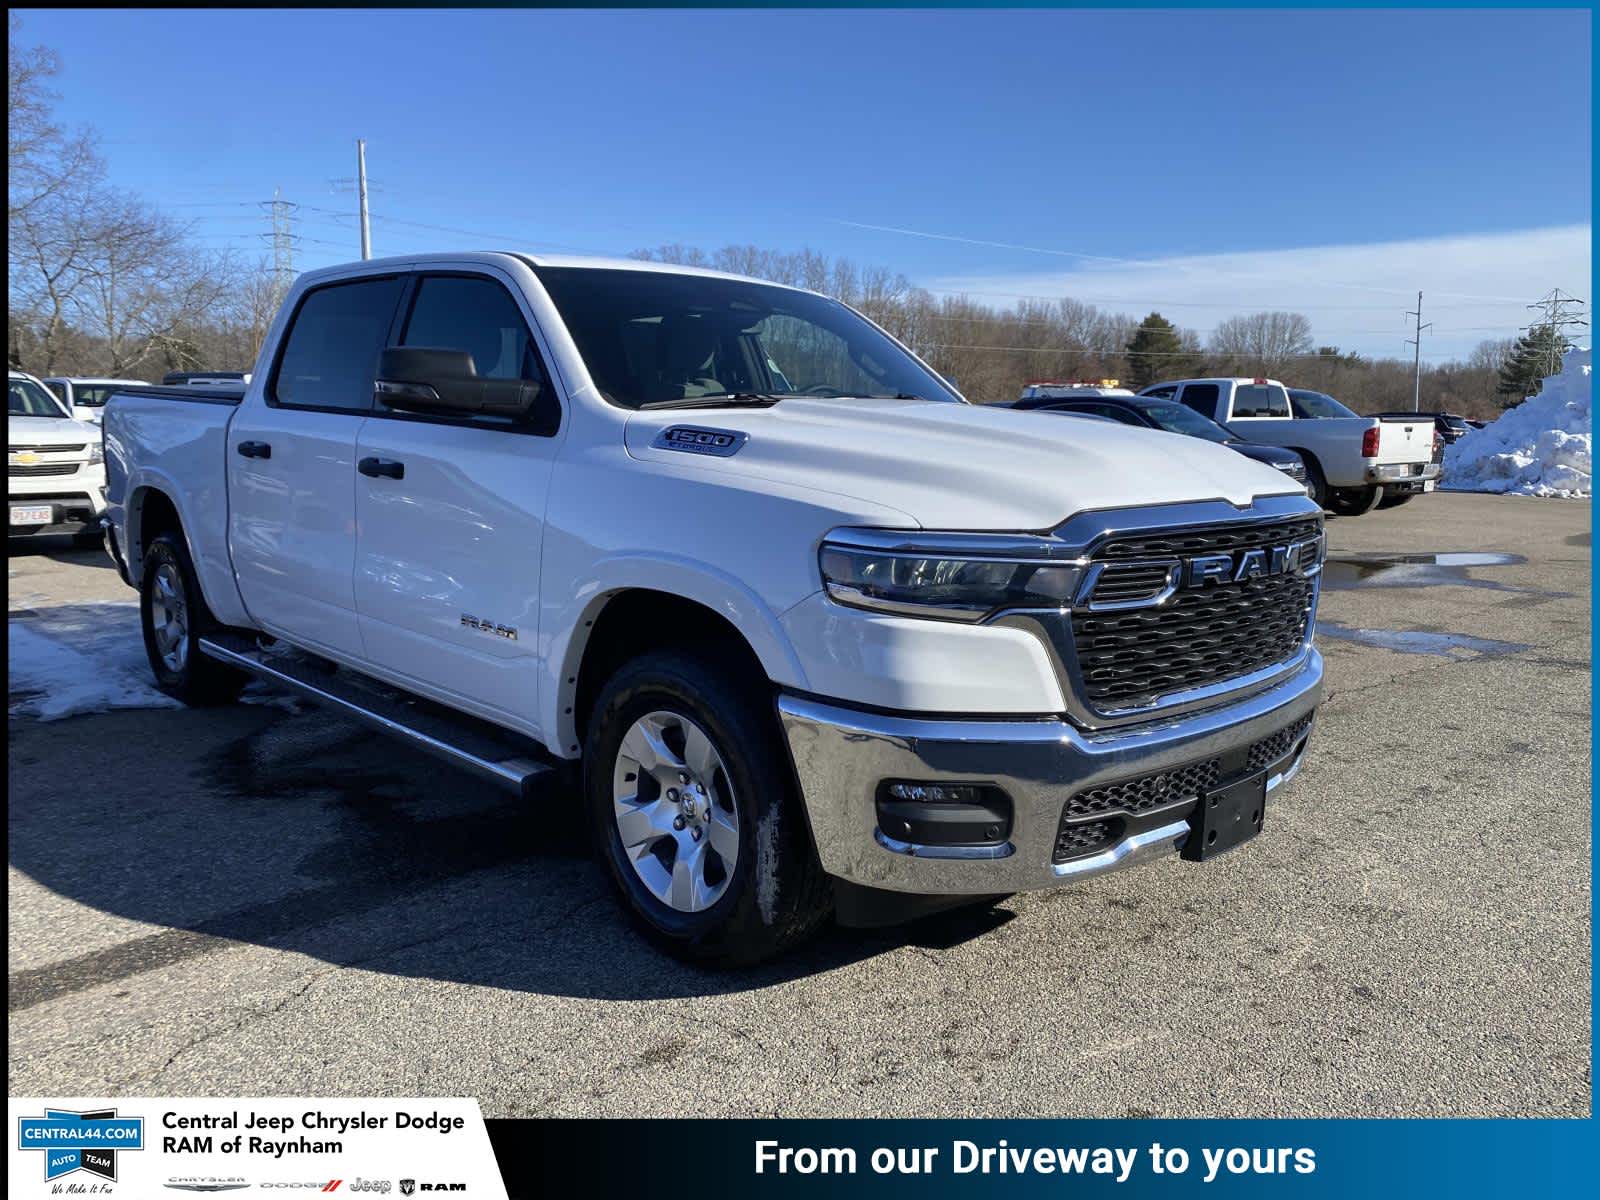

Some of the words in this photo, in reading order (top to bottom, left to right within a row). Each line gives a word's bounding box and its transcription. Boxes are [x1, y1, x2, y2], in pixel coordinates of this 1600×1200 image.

[671, 430, 732, 446] 1500
[1189, 545, 1300, 587] RAM
[461, 613, 518, 640] RAM
